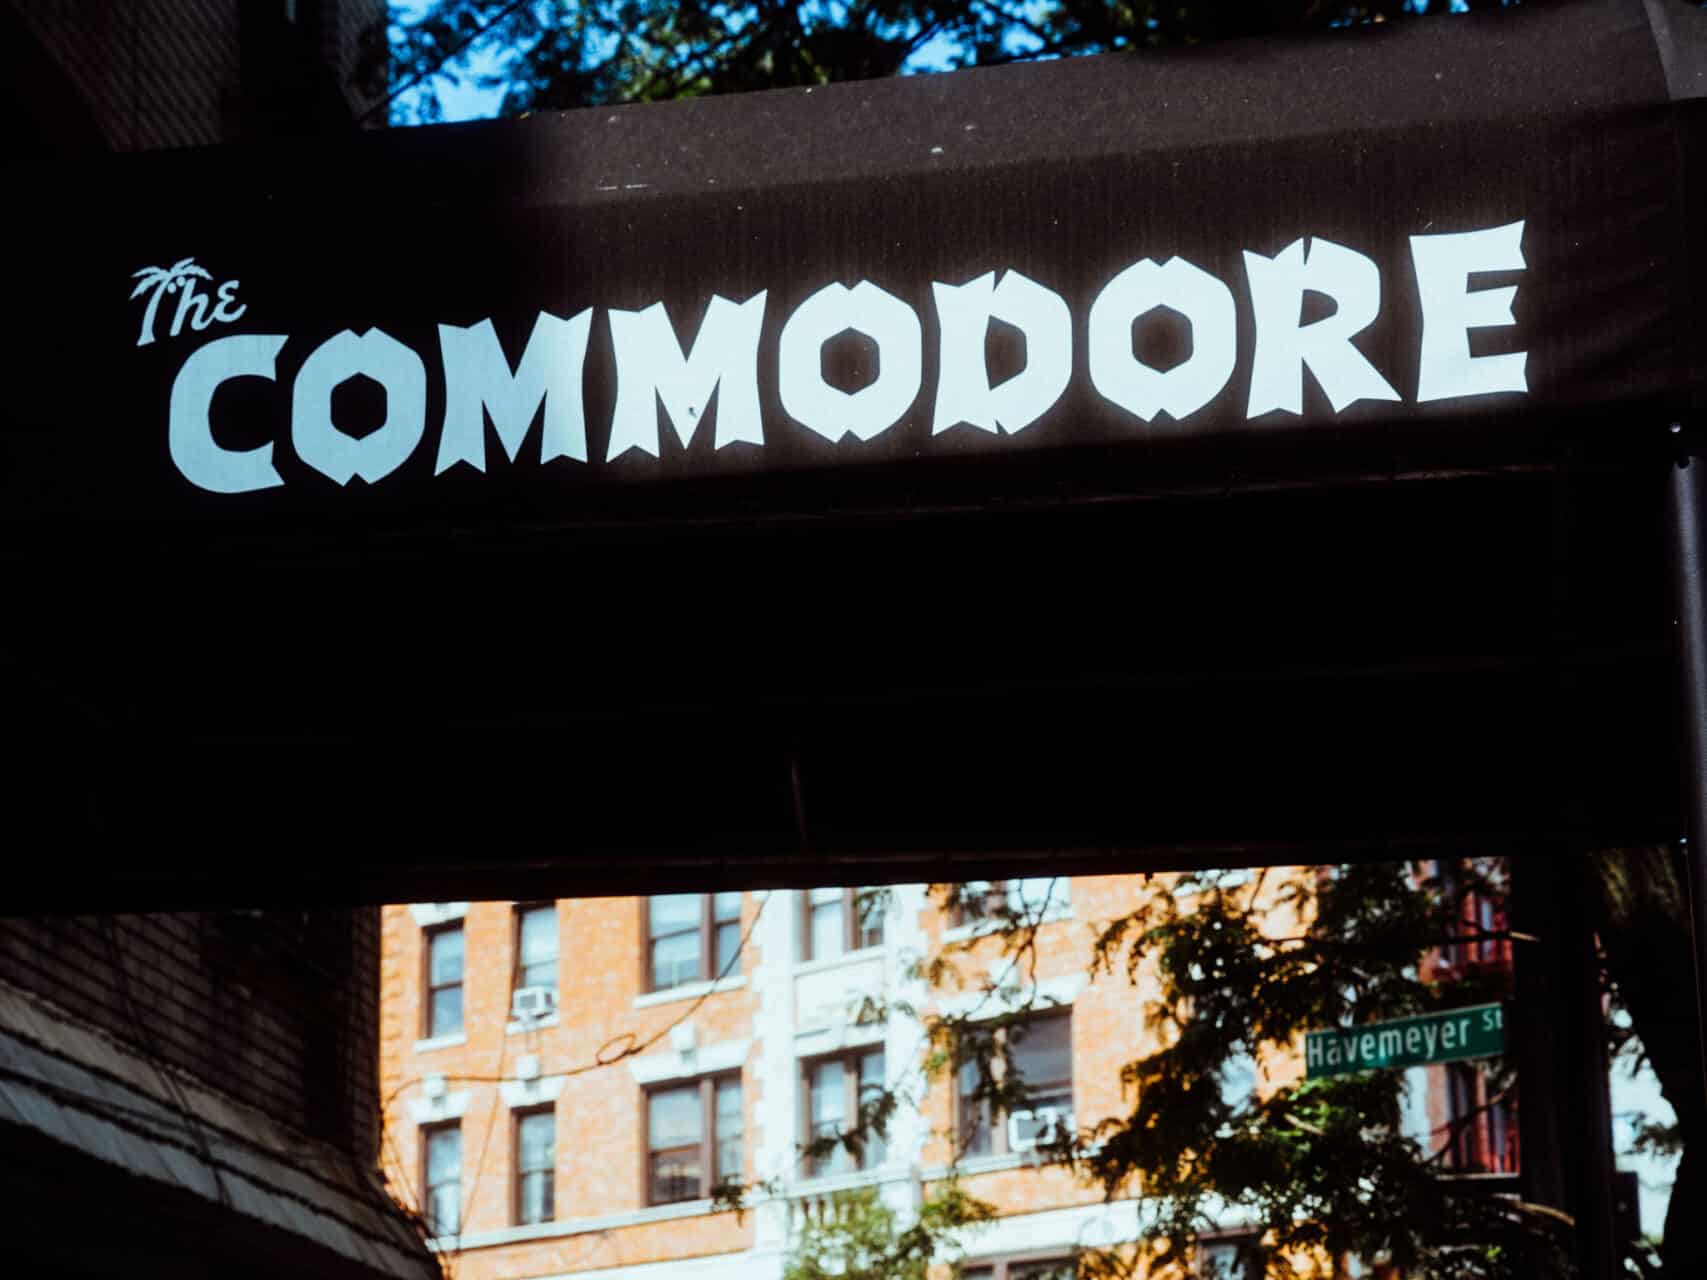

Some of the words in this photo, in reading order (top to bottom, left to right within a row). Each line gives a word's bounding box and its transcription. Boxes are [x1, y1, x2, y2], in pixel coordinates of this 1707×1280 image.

[130, 257, 247, 346] The
[170, 219, 1529, 494] COMMODORE
[1308, 1018, 1470, 1068] Havemeyer
[1482, 1010, 1503, 1031] St
